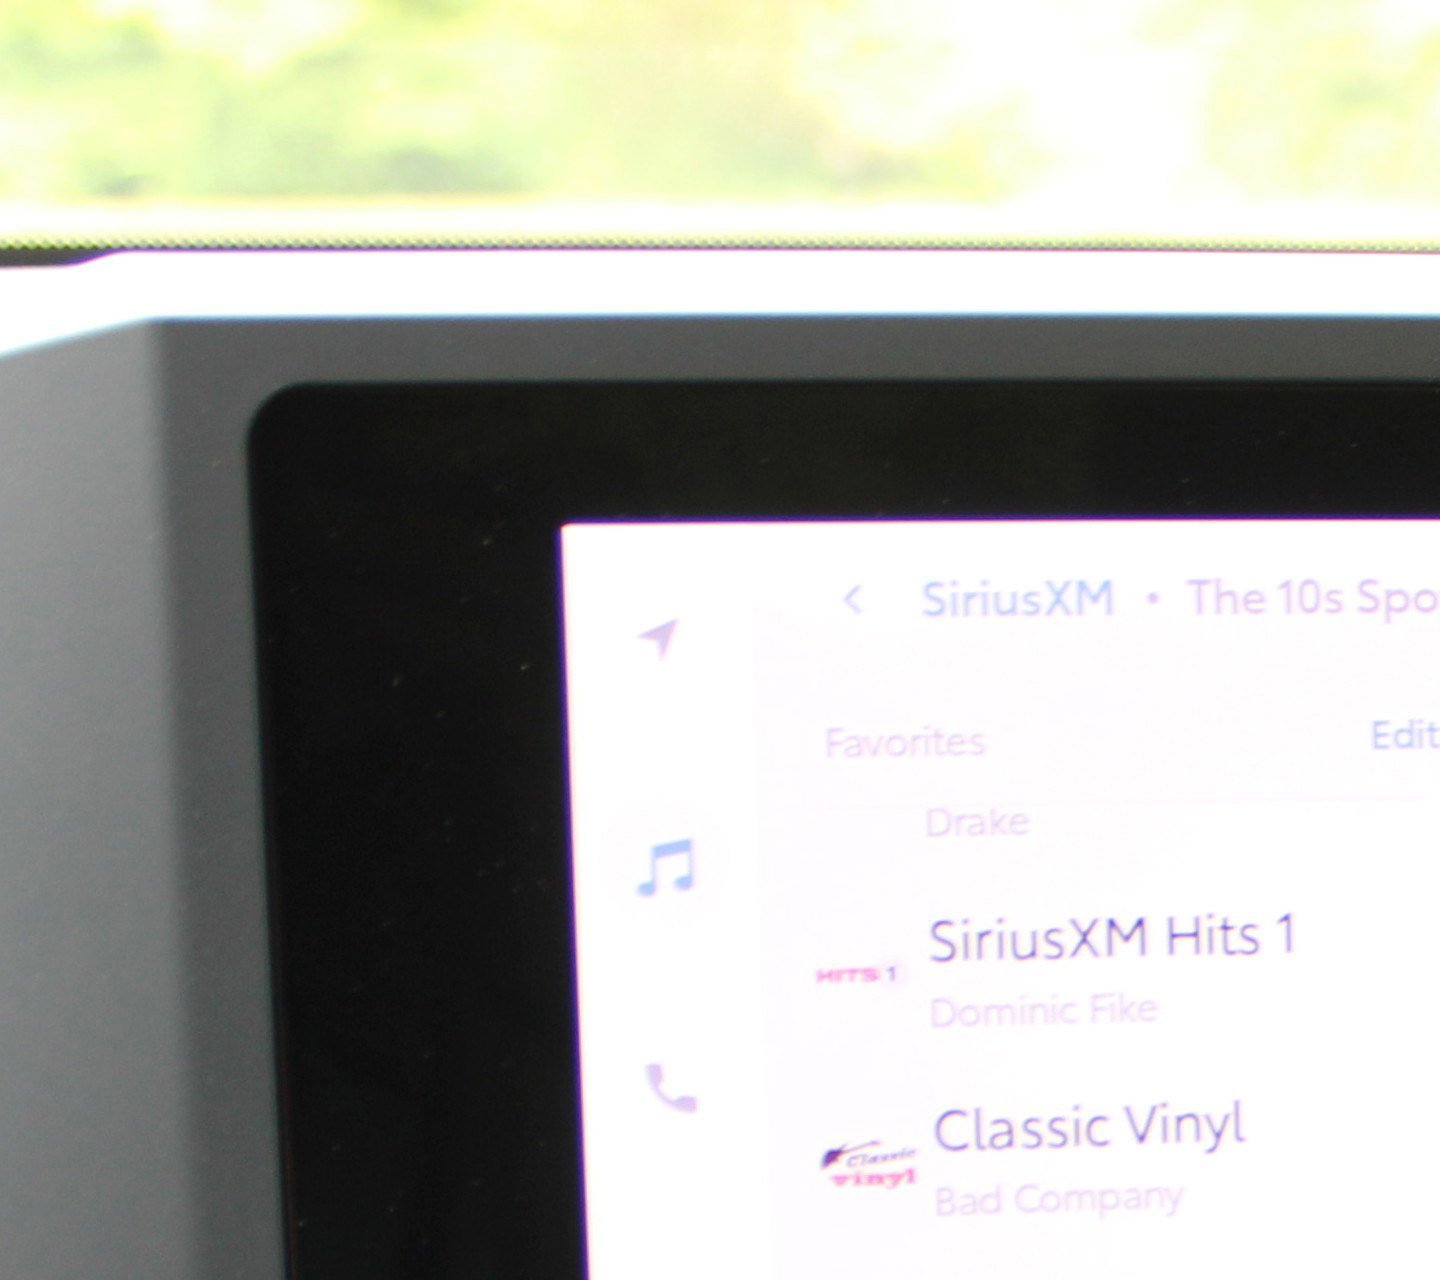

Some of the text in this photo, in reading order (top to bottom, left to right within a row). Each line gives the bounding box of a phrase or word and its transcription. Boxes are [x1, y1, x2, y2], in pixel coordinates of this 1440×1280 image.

[921, 578, 1115, 619] SiriusXM
[1184, 577, 1268, 616] The
[1277, 577, 1345, 616] 10s
[824, 724, 989, 760] Favorites
[925, 805, 1032, 839] Drake
[929, 912, 1293, 964] SiriusXM Hits 1
[929, 991, 1160, 1030] Dominic Fike
[933, 1099, 1247, 1156] Classic Vinyl
[934, 1182, 1186, 1221] Bad Company
